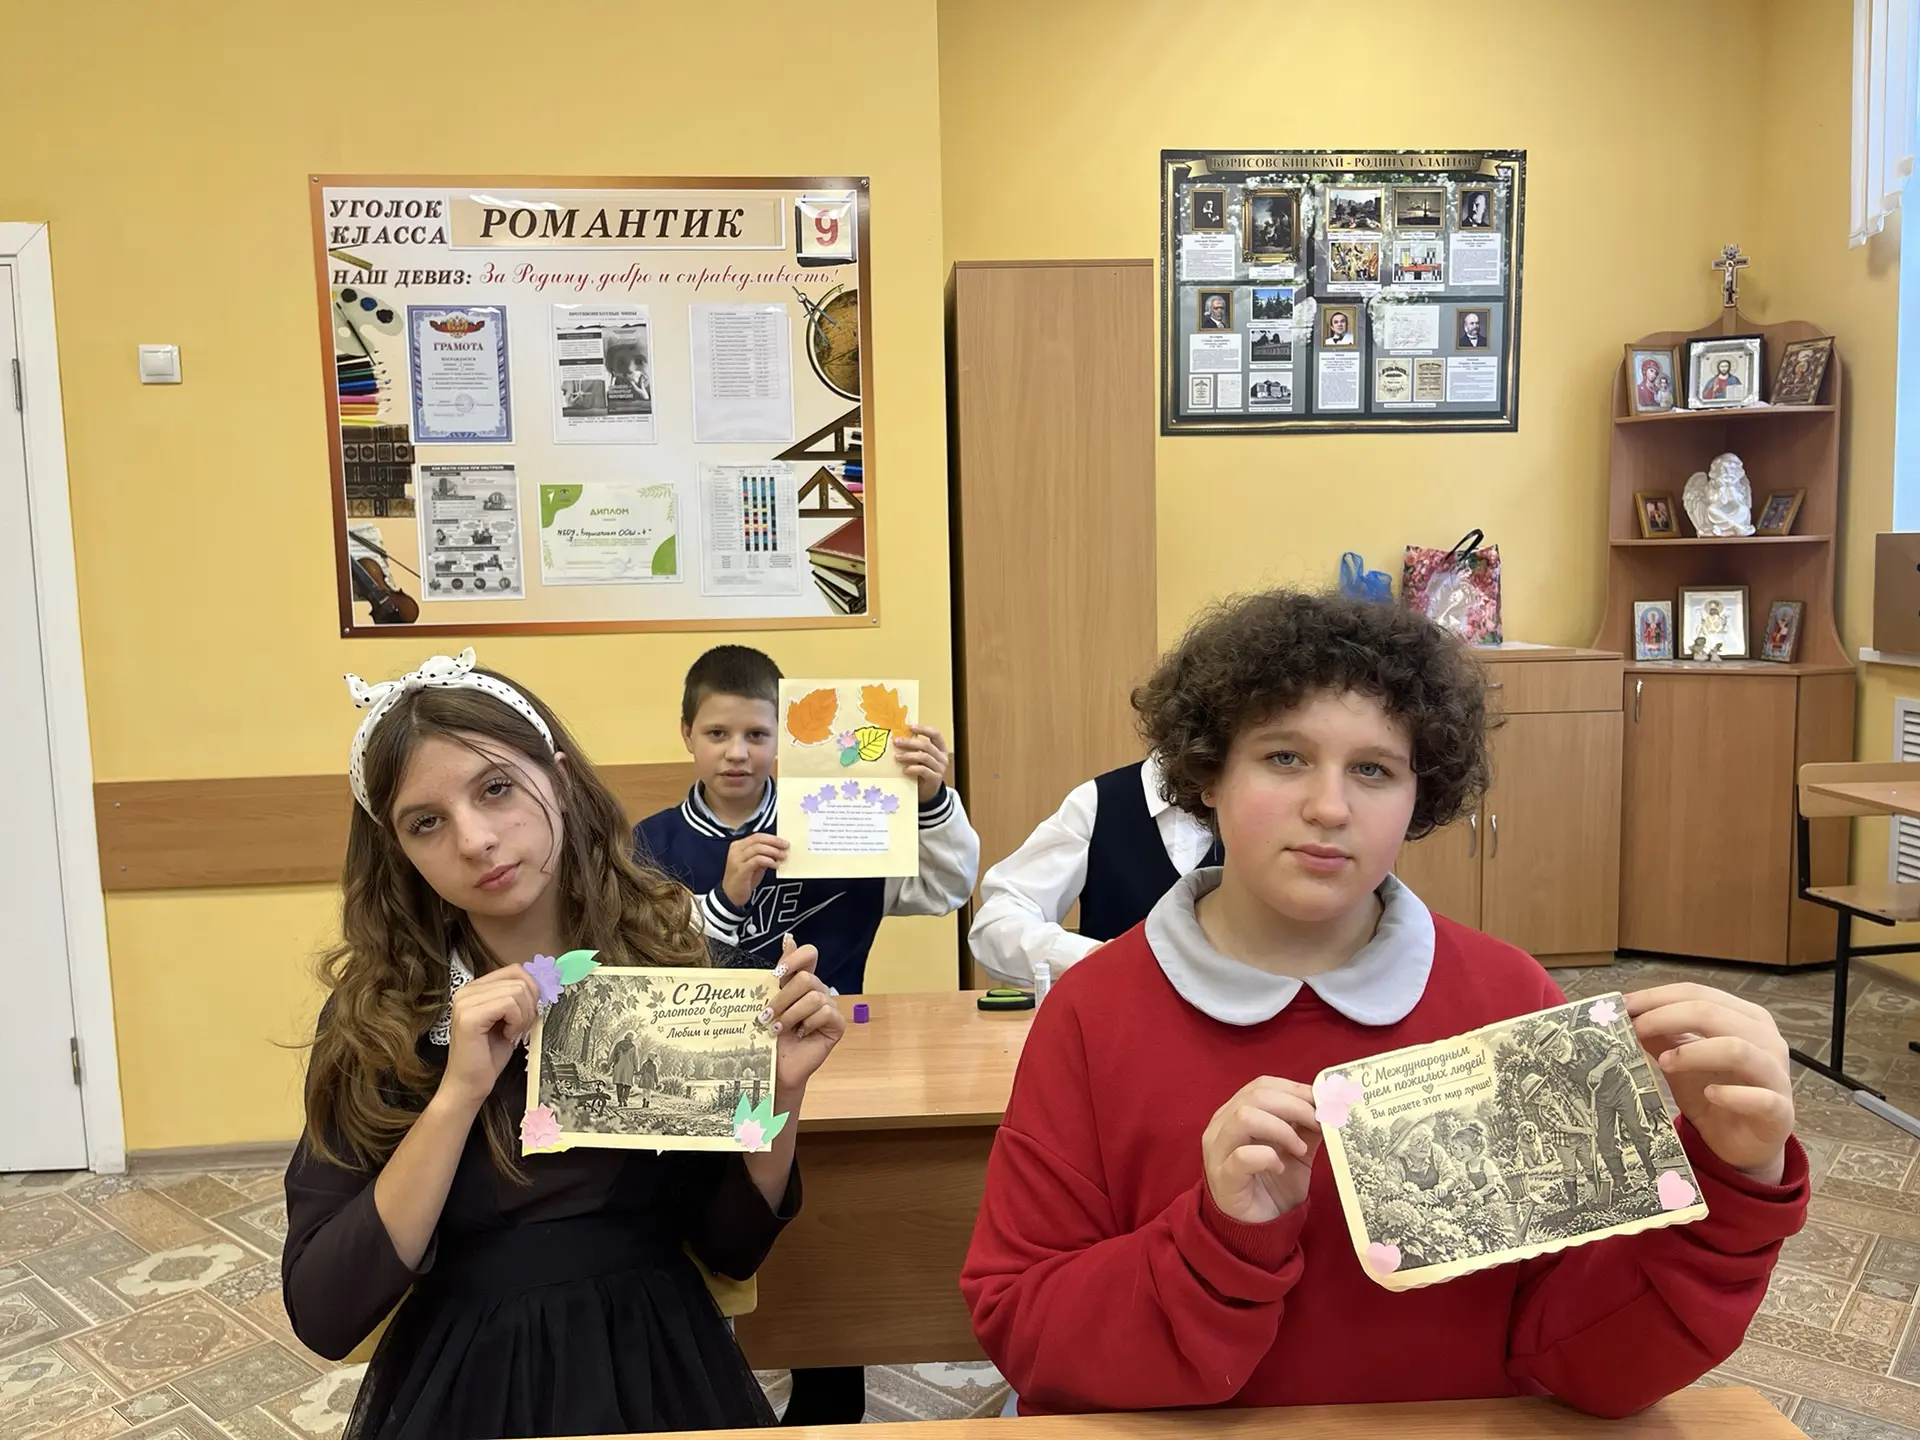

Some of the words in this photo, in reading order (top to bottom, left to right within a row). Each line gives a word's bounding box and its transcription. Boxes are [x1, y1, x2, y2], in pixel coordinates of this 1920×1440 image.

[1212, 155, 1309, 169] БОРИСОВСКИЙ
[1312, 155, 1344, 168] КРАЙ
[1354, 157, 1405, 169] РОДИНА
[1409, 156, 1476, 168] ТАЛАНТОВ
[329, 199, 443, 219] УГОЛОК
[479, 208, 745, 239] РОМАНТИК
[814, 209, 839, 247] 9
[330, 225, 448, 245] КЛАССА
[332, 269, 389, 286] НАШ
[393, 269, 473, 289] ДЕВИЗ:
[478, 261, 507, 285] За
[596, 261, 652, 293] добро
[658, 272, 671, 284] и
[676, 263, 840, 293] справедливость!
[432, 341, 485, 351] ГРАМОТА
[589, 507, 630, 516] ДИПЛОМ
[672, 982, 689, 1006] С
[689, 982, 746, 1006] Днем
[650, 1005, 706, 1025] золотого
[665, 1026, 701, 1039] Любим
[703, 1029, 710, 1037] и
[712, 1023, 747, 1039] ценим!
[1361, 1071, 1371, 1088] С
[1374, 1046, 1471, 1084] Международным
[1362, 1088, 1392, 1106] днем
[1394, 1070, 1449, 1092] пожилых
[1449, 1049, 1487, 1076] людей!
[1370, 1108, 1386, 1120] Вы
[1387, 1099, 1421, 1117] делаете
[1422, 1093, 1442, 1106] этот
[1444, 1088, 1463, 1101] мир
[1464, 1076, 1494, 1097] лучше!
